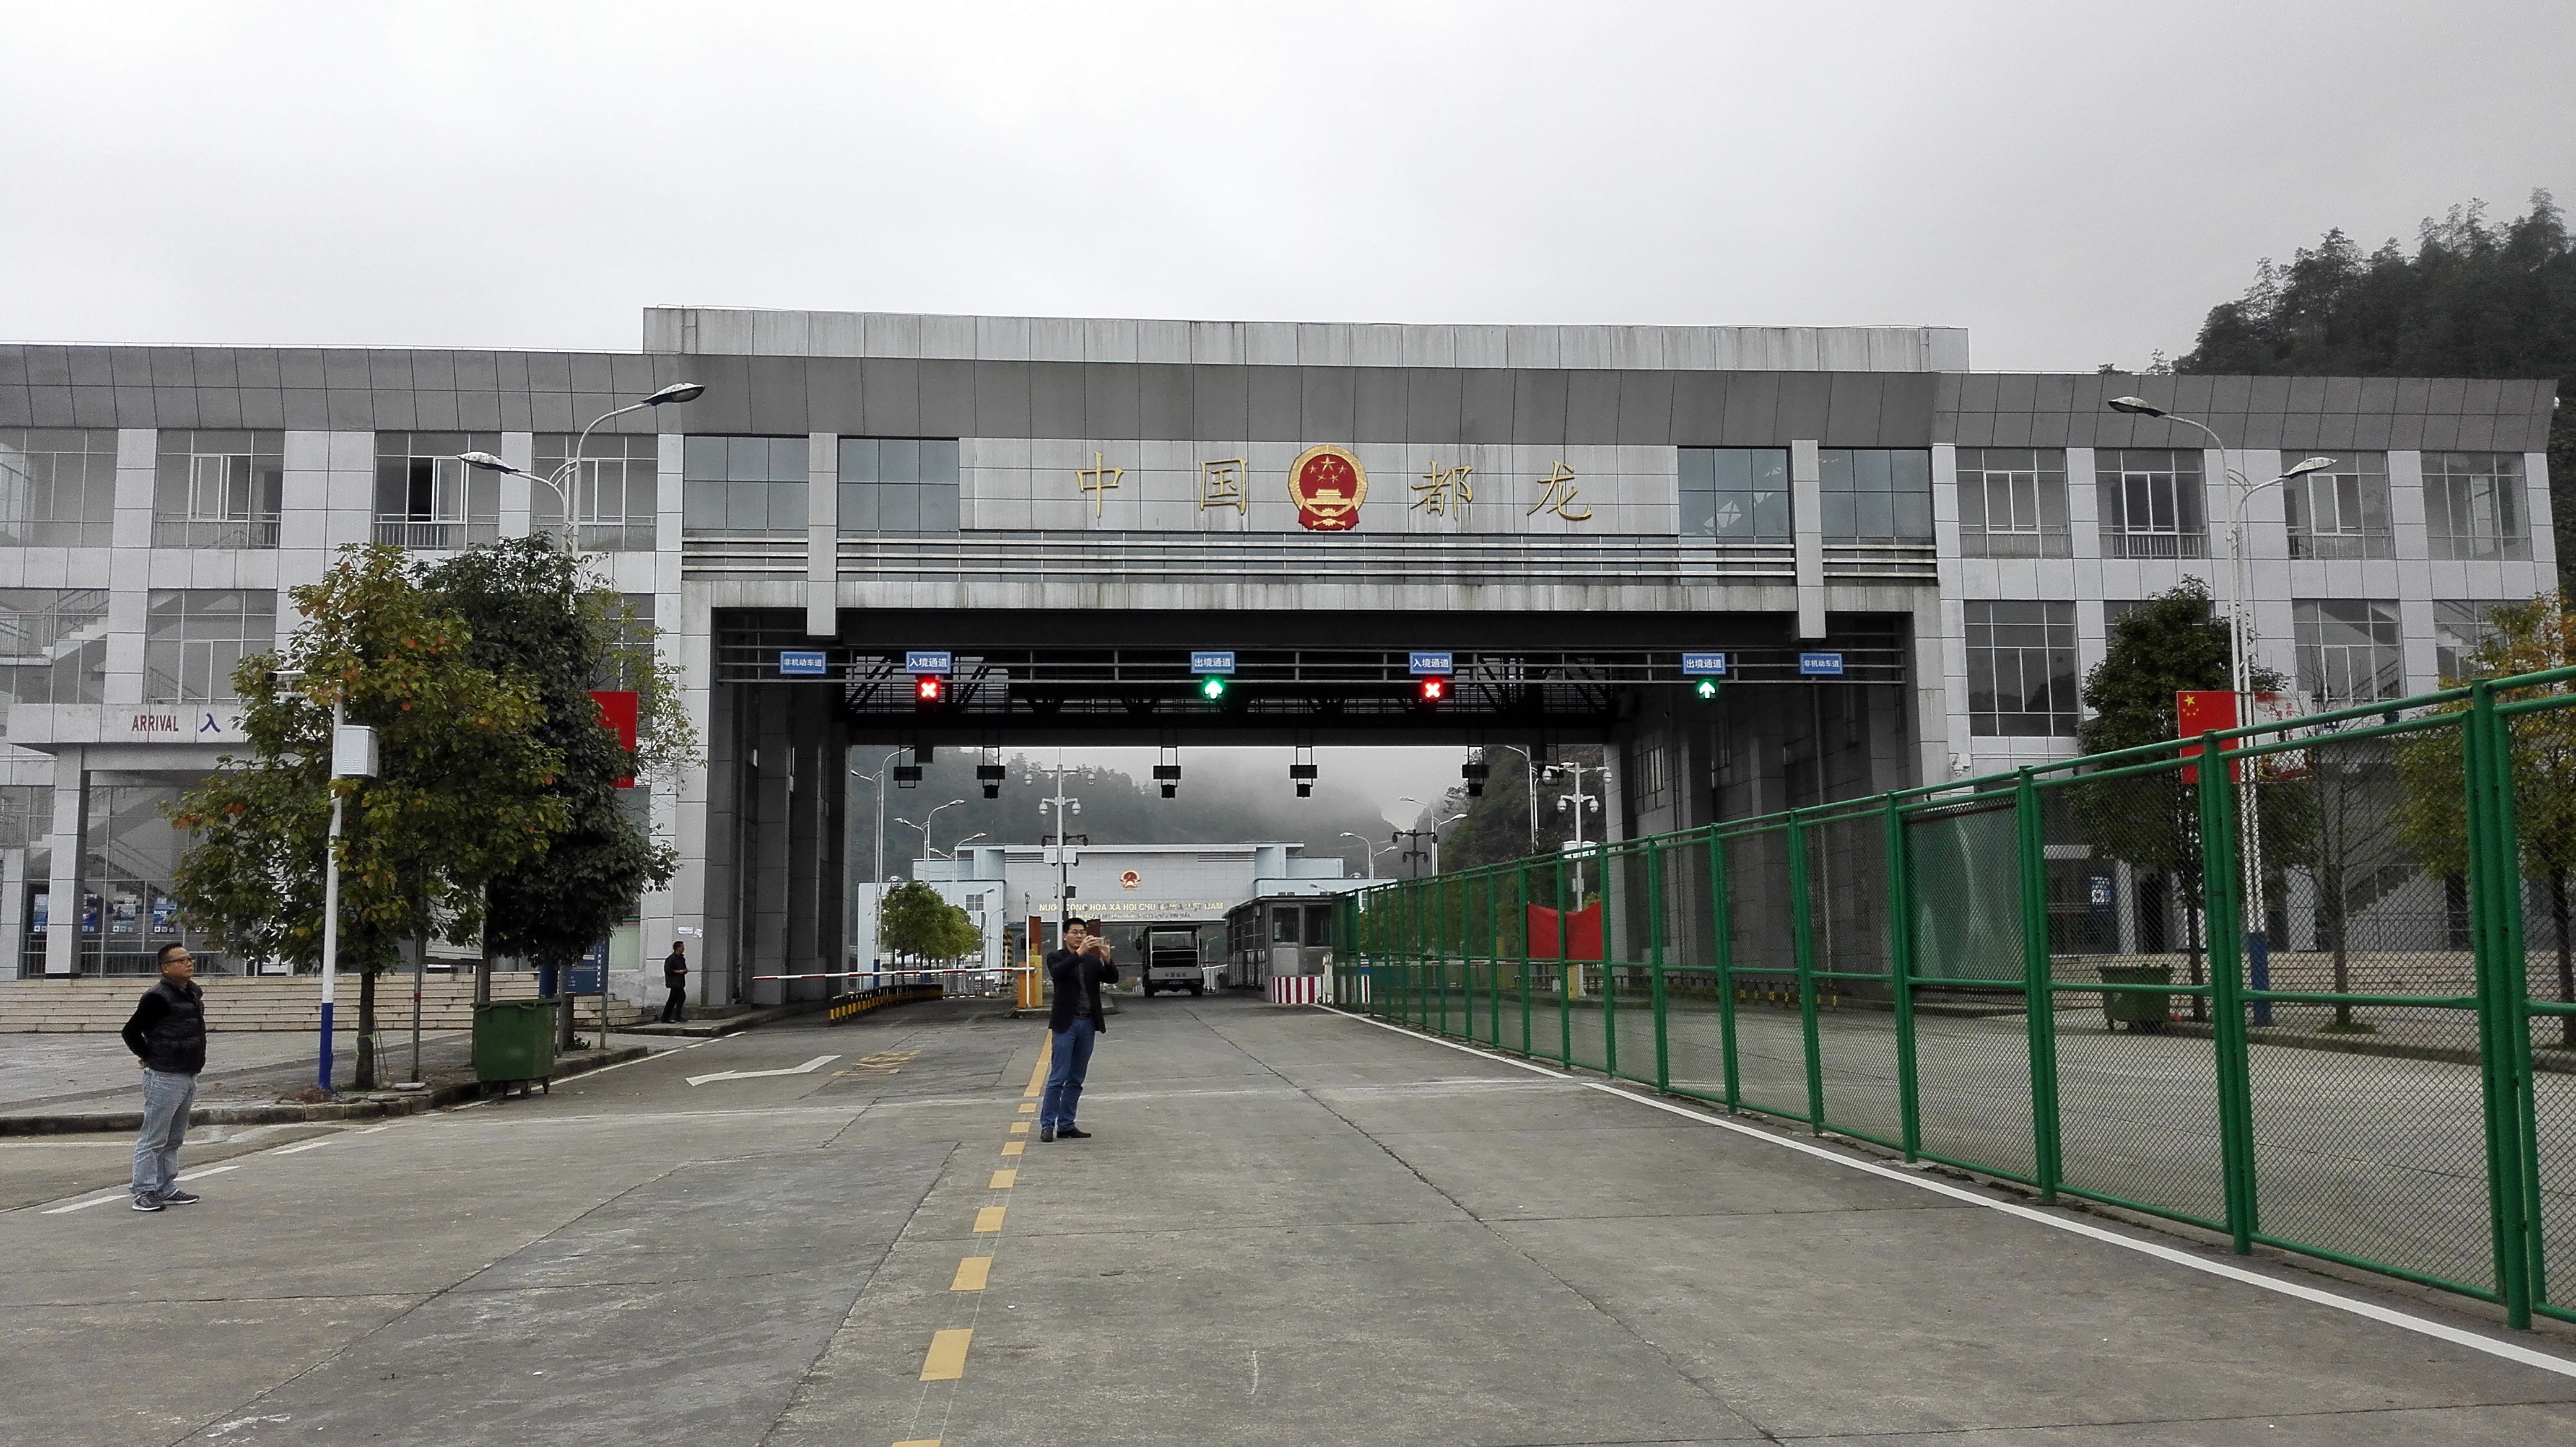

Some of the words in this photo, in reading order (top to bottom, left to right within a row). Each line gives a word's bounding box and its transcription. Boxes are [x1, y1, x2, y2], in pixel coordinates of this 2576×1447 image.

[783, 658, 822, 667] 非机动车道
[909, 658, 947, 668] 入境通道
[1194, 658, 1231, 667] 出境通道
[1412, 658, 1450, 668] 入境通道
[1686, 659, 1722, 668] 出境通道
[1803, 660, 1840, 668] 非机动车道
[132, 715, 179, 732] ARRIVAL
[199, 712, 221, 733] 入
[1039, 903, 1058, 911] NƯỚ
[1204, 903, 1224, 911] NAM
